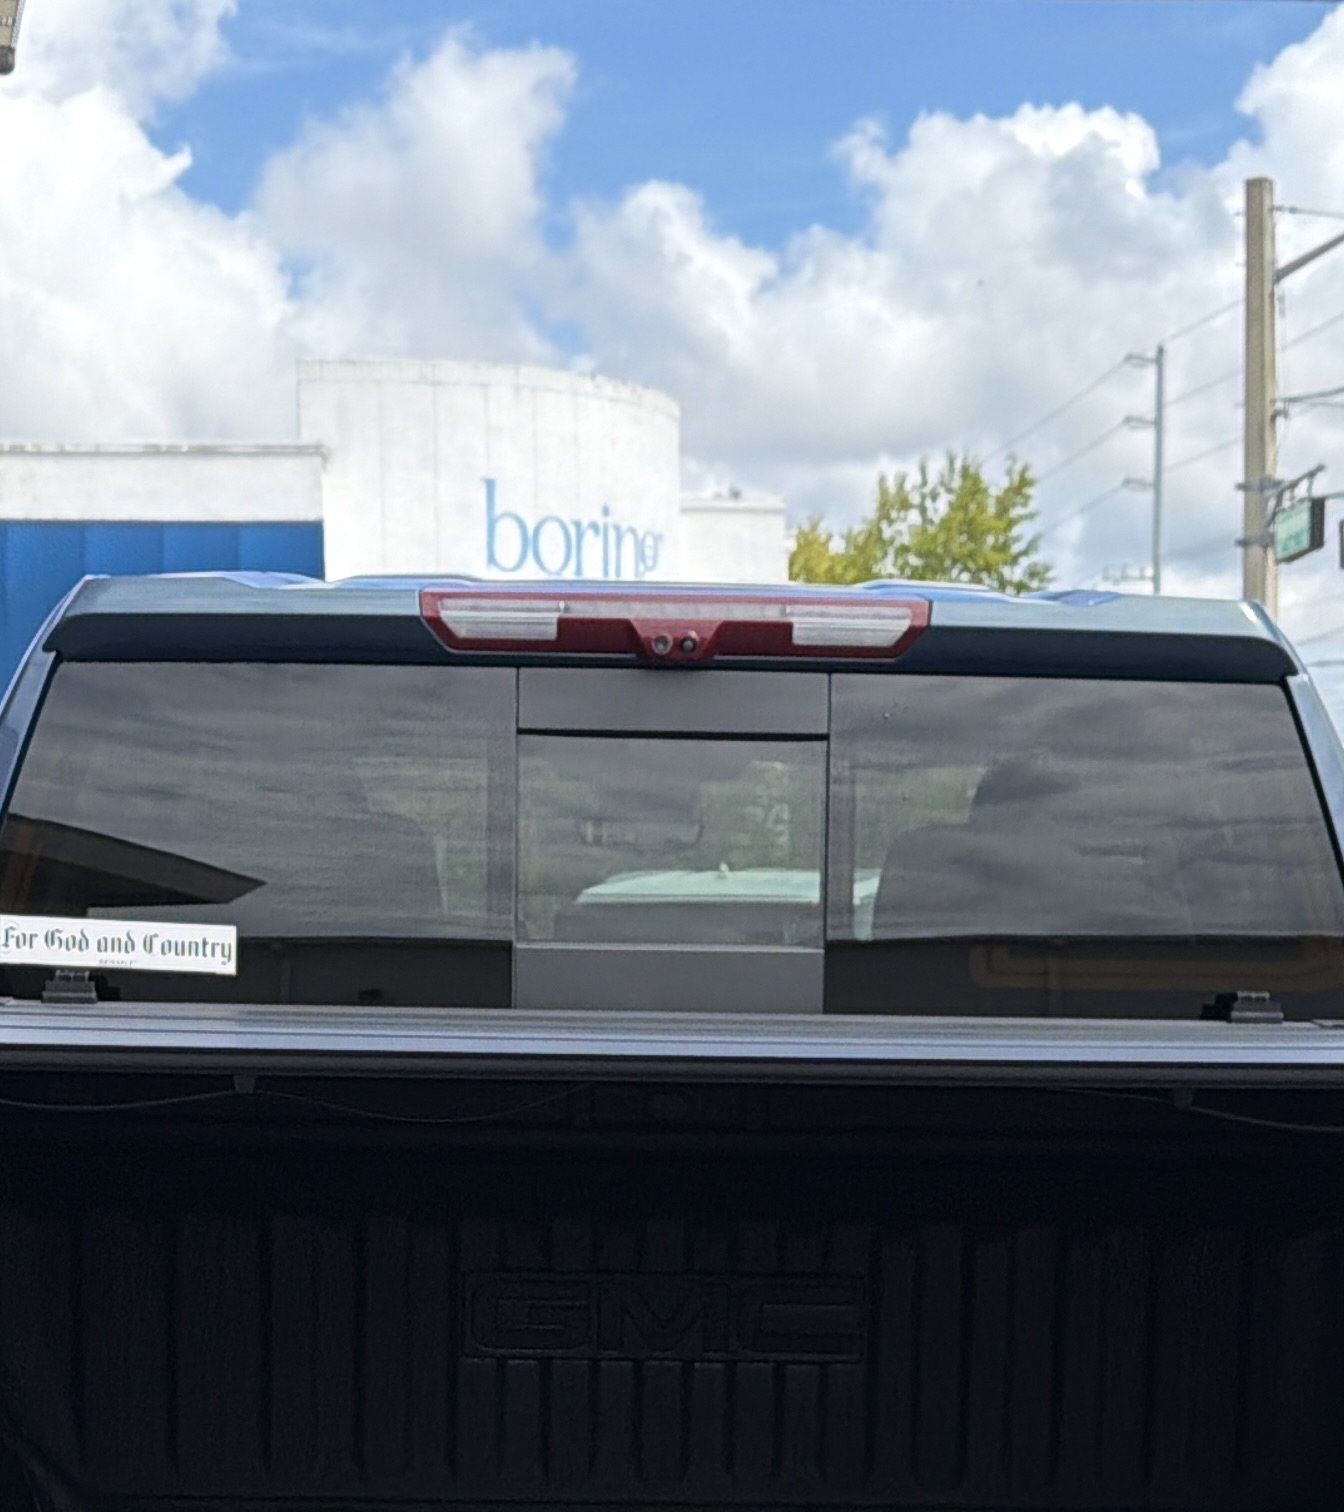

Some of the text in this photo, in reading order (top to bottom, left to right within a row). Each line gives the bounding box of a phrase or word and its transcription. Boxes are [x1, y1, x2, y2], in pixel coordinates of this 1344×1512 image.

[481, 478, 663, 579] boring
[1, 926, 233, 966] For God and Country
[470, 1276, 865, 1354] GMC
